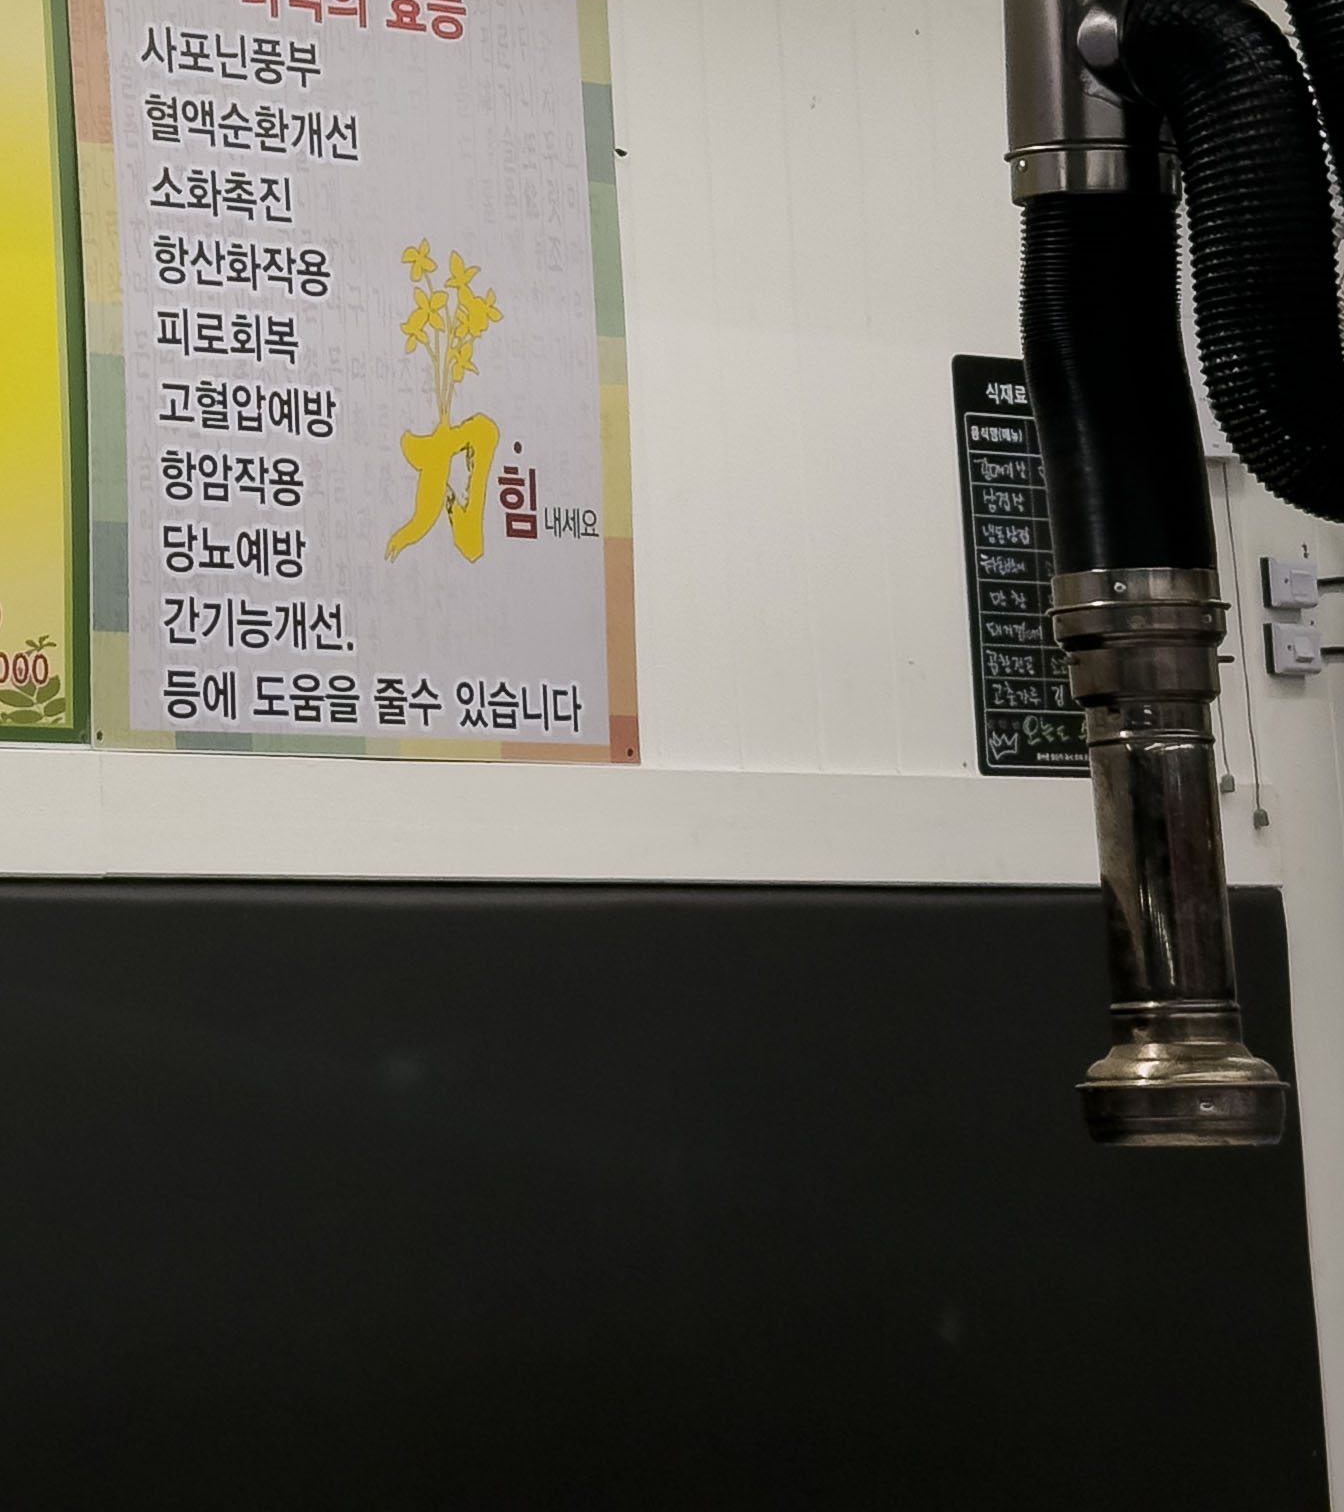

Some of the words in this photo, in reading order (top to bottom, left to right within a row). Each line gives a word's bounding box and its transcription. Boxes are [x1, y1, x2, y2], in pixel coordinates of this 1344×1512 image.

[141, 26, 321, 90] 사포닌풍부
[145, 91, 358, 166] 혈액순환개선
[150, 165, 293, 223] 소화촉진
[153, 235, 331, 297] 항산화작용
[157, 306, 299, 368] 피로회복
[159, 380, 337, 439] 고혈압예방
[161, 447, 304, 506] 항암작용
[163, 523, 306, 578] 당뇨예방
[545, 507, 599, 539] 내세요
[164, 596, 353, 651] 간기능개선.
[164, 668, 236, 720] 등에
[253, 674, 360, 723] 도움을
[373, 677, 442, 726] 줄수
[456, 680, 582, 732] 있습니다
